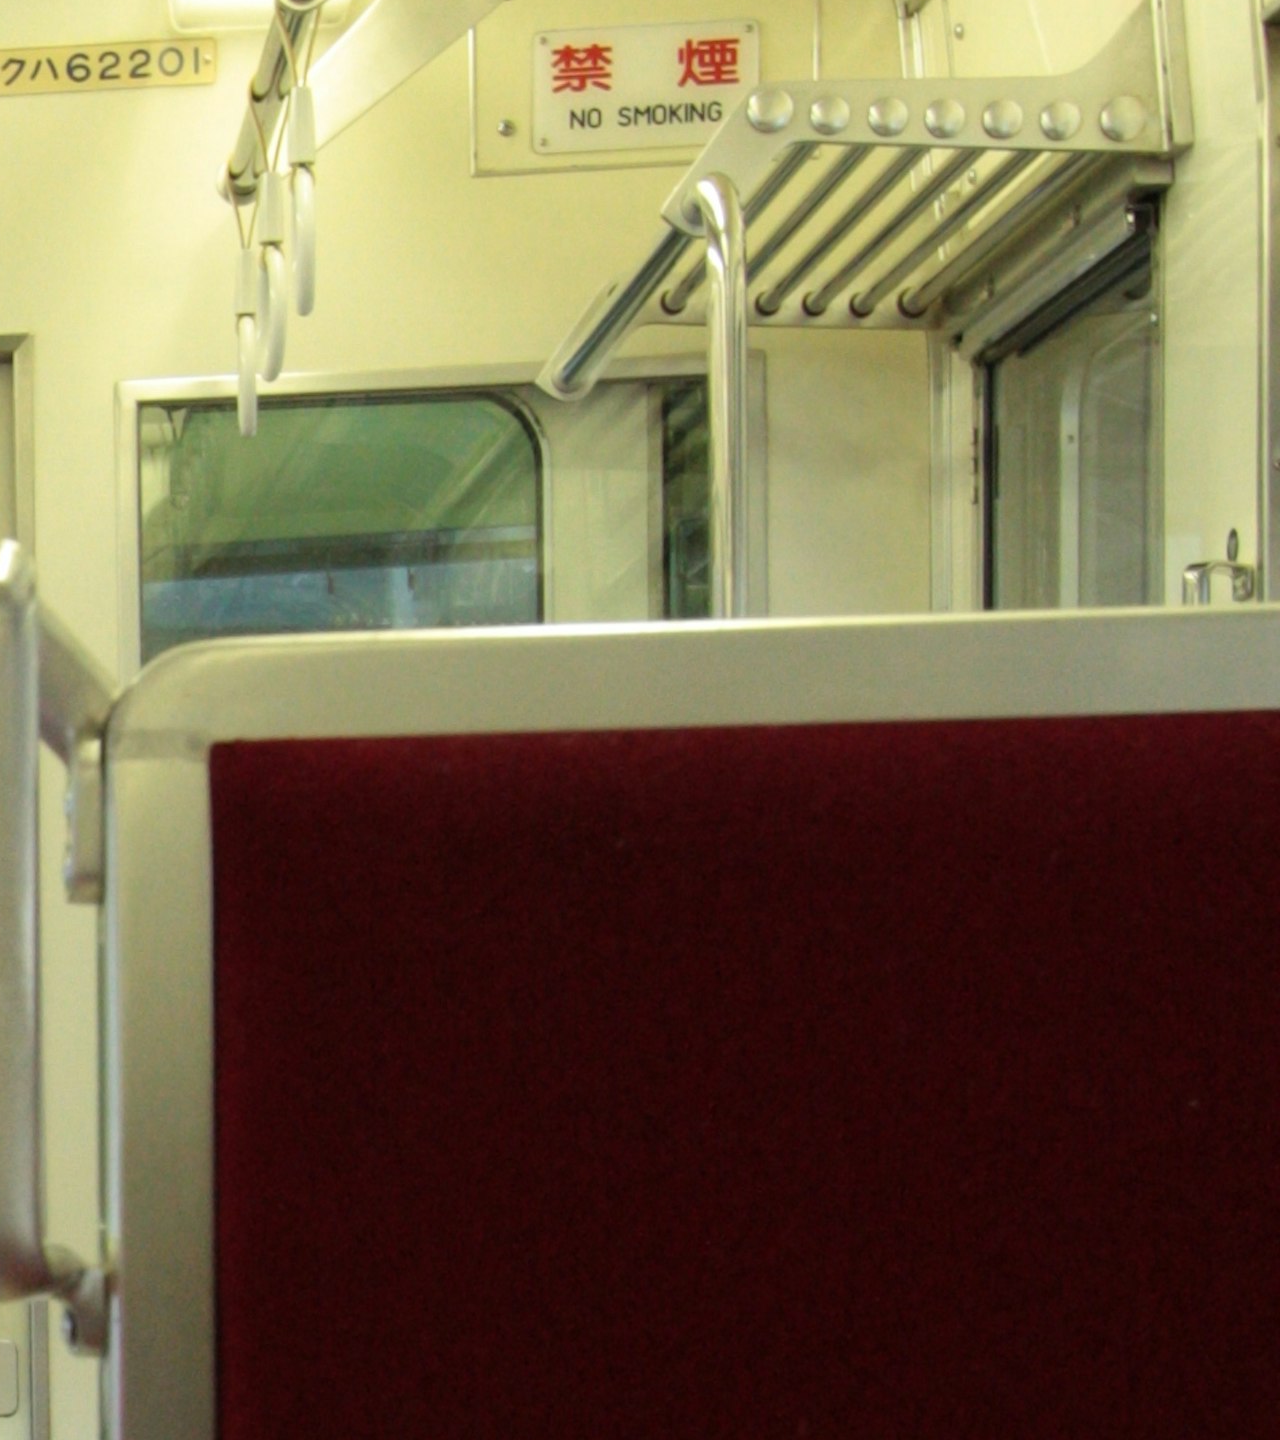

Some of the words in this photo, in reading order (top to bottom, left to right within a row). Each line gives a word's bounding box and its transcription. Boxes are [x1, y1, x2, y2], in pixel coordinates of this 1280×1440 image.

[2, 46, 200, 86] クハ62201
[551, 37, 742, 94] 禁煙
[570, 107, 603, 130] NO
[618, 101, 723, 127] SMOKING
